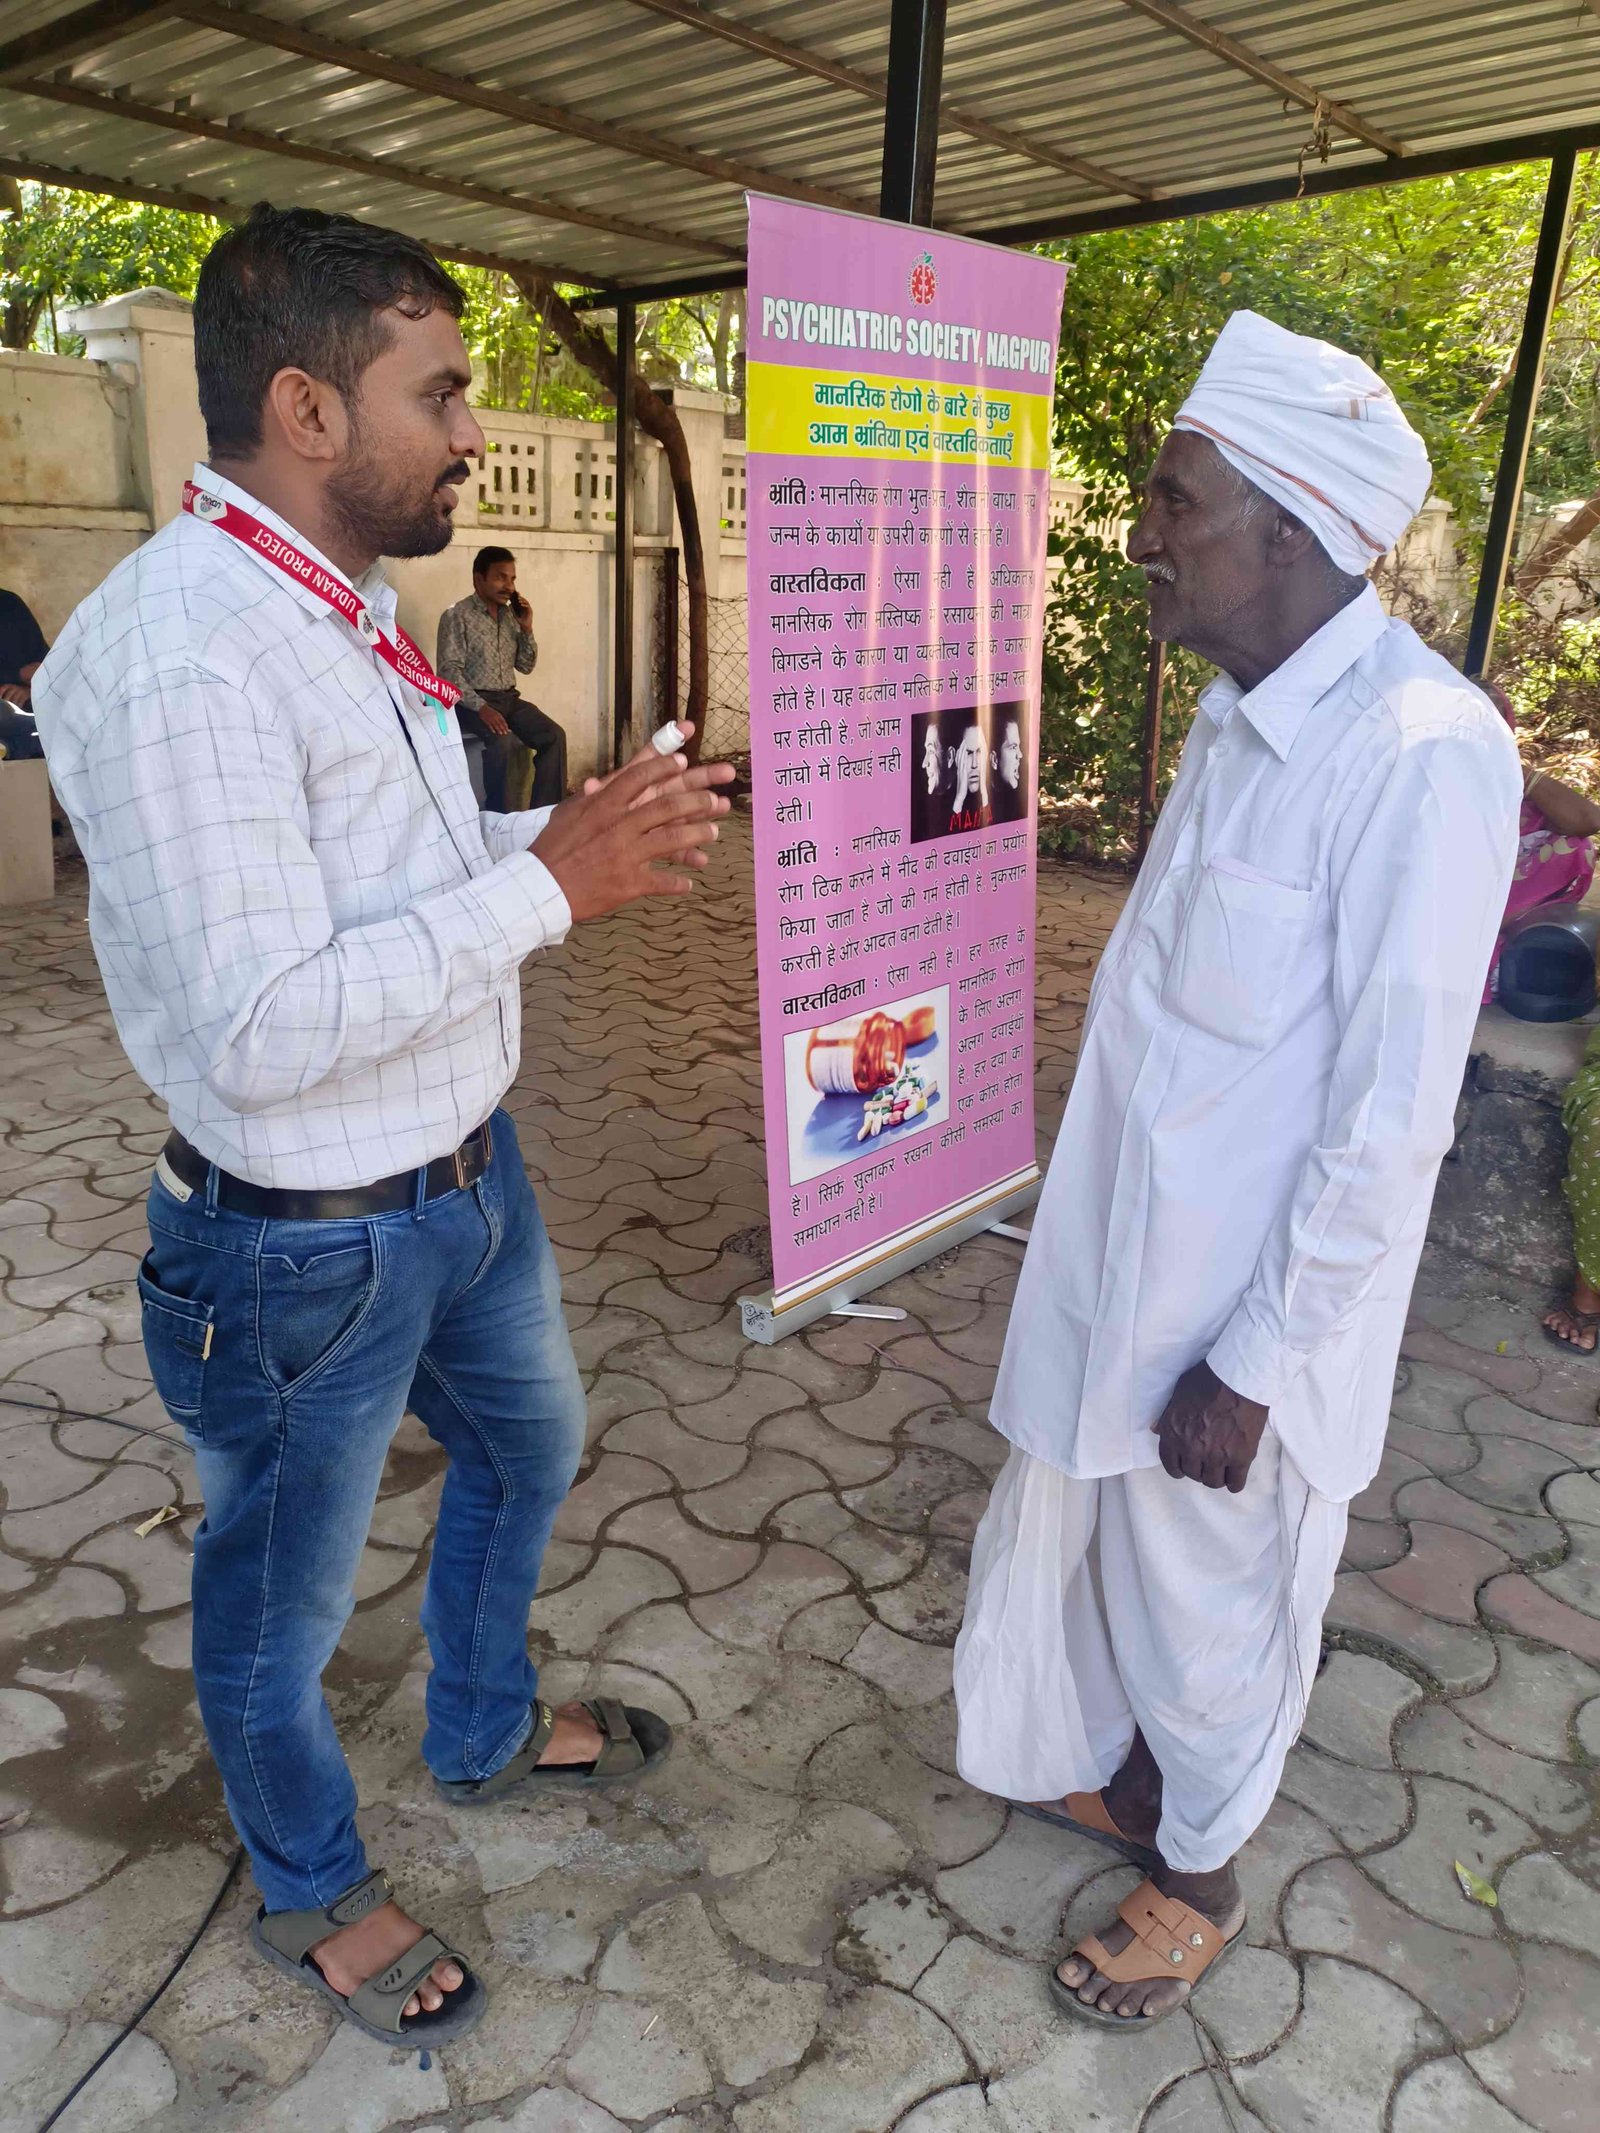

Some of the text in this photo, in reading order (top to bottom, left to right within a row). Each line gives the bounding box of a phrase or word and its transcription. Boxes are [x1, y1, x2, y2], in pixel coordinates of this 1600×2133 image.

[762, 296, 1050, 374] PSYCHIATRIC SOCIETY, NAGPUR
[815, 379, 886, 408] मानसिक
[927, 388, 941, 414] के
[944, 392, 969, 417] बारे
[985, 402, 1011, 429] कुछ
[809, 423, 848, 444] आम
[905, 424, 930, 454] एवं
[819, 479, 878, 505] मानसिक
[883, 481, 903, 506] रोग
[769, 526, 800, 545] जन्म
[805, 519, 821, 545] के
[867, 526, 880, 545] या
[882, 520, 914, 545] उपरी
[957, 522, 970, 545] से
[251, 528, 357, 614] UDAAN PROJECT
[769, 567, 867, 593] वास्तविकता
[893, 565, 920, 594] ऐसा
[770, 606, 833, 633] मानसिक
[844, 605, 868, 630] रोग
[990, 599, 1004, 621] की
[396, 657, 439, 693] PROJECT
[772, 645, 822, 673] बिगडने
[831, 644, 847, 669] के
[855, 647, 886, 666] कारण
[893, 646, 909, 663] या
[772, 686, 798, 713] होते
[831, 688, 853, 707] यह
[948, 670, 959, 693] में
[773, 731, 792, 749] पर
[797, 720, 832, 748] होती
[858, 716, 871, 739] जो
[875, 718, 902, 736] आम
[818, 756, 831, 781] में
[837, 750, 873, 780] दिखाई
[878, 746, 902, 772] नही
[777, 840, 817, 868] भ्रांति
[852, 826, 902, 853] मानसिक
[778, 880, 803, 903] रोग
[812, 874, 843, 899] ठिक
[849, 864, 874, 890] करने
[880, 858, 890, 881] में
[925, 848, 938, 871] की
[985, 840, 997, 856] का
[1002, 831, 1027, 852] प्रयोग
[780, 916, 816, 940] किया
[826, 909, 855, 929] जाता
[861, 899, 869, 922] है
[877, 893, 893, 915] जो
[901, 887, 915, 910] की
[945, 873, 969, 899] होती
[991, 864, 1027, 892] नुकसान
[781, 945, 821, 974] करती
[826, 943, 836, 967] है
[840, 938, 860, 960] और
[863, 931, 896, 953] आदत
[900, 924, 920, 943] बना
[923, 912, 943, 936] देती
[782, 978, 865, 1015] वास्तविकता
[888, 965, 910, 988] ऐसा
[919, 951, 937, 975] नही
[969, 944, 982, 961] हर
[988, 934, 1008, 953] तरह
[1017, 926, 1026, 943] के
[958, 967, 997, 993] मानसिक
[959, 1005, 968, 1023] के
[974, 998, 992, 1019] लिए
[958, 1032, 984, 1053] अलग
[974, 1060, 987, 1078] हर
[991, 1051, 1008, 1068] दवा
[1012, 1045, 1023, 1060] का
[957, 1094, 974, 1113] एक
[1004, 1073, 1023, 1094] होता
[819, 1176, 845, 1206] सिर्फ
[853, 1158, 896, 1194] सुलाकर
[904, 1141, 933, 1165] रखना
[940, 1121, 966, 1148] कीसी
[973, 1109, 1004, 1133] समस्या
[1011, 1101, 1023, 1116] का
[793, 1214, 841, 1247] समाधान
[844, 1197, 865, 1222] नही
